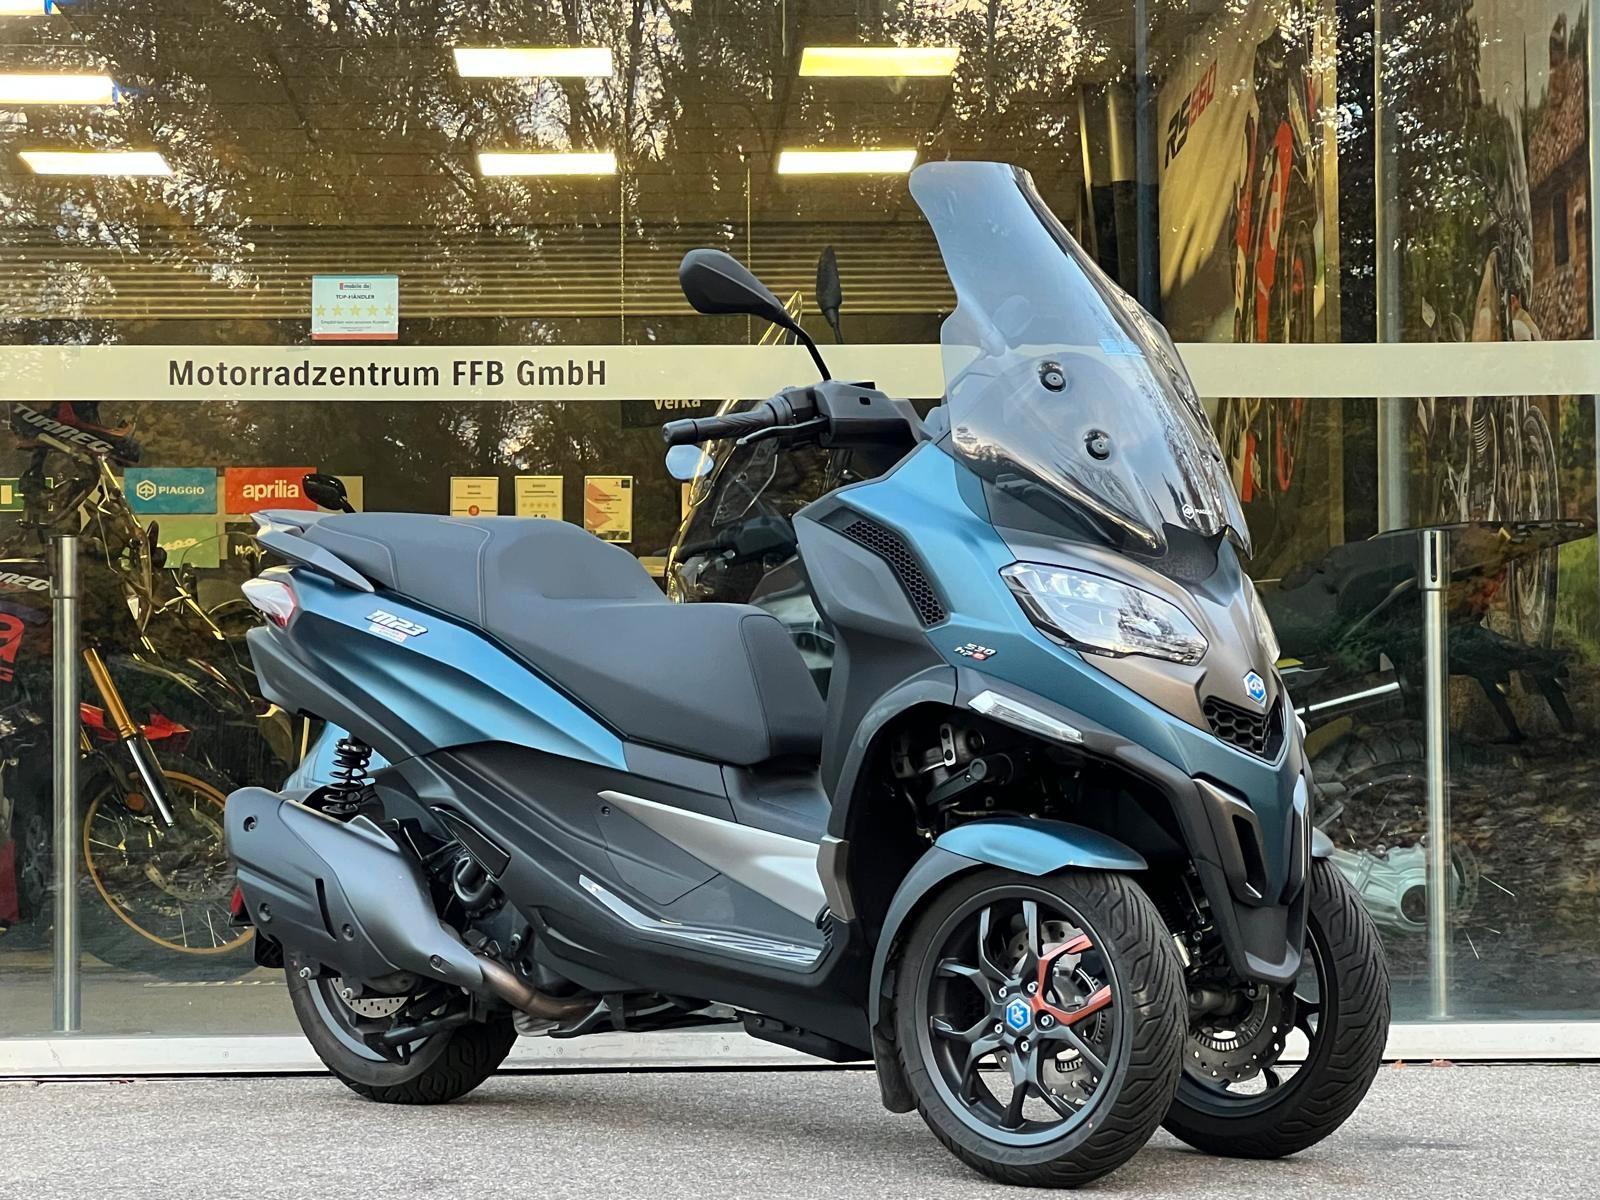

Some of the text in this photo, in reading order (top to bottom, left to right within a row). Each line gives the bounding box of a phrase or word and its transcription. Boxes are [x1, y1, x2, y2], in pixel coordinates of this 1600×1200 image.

[169, 360, 606, 387] Motorradzentrum FFB GmbH
[158, 485, 205, 495] PIAGGIO
[242, 479, 299, 502] aprilia
